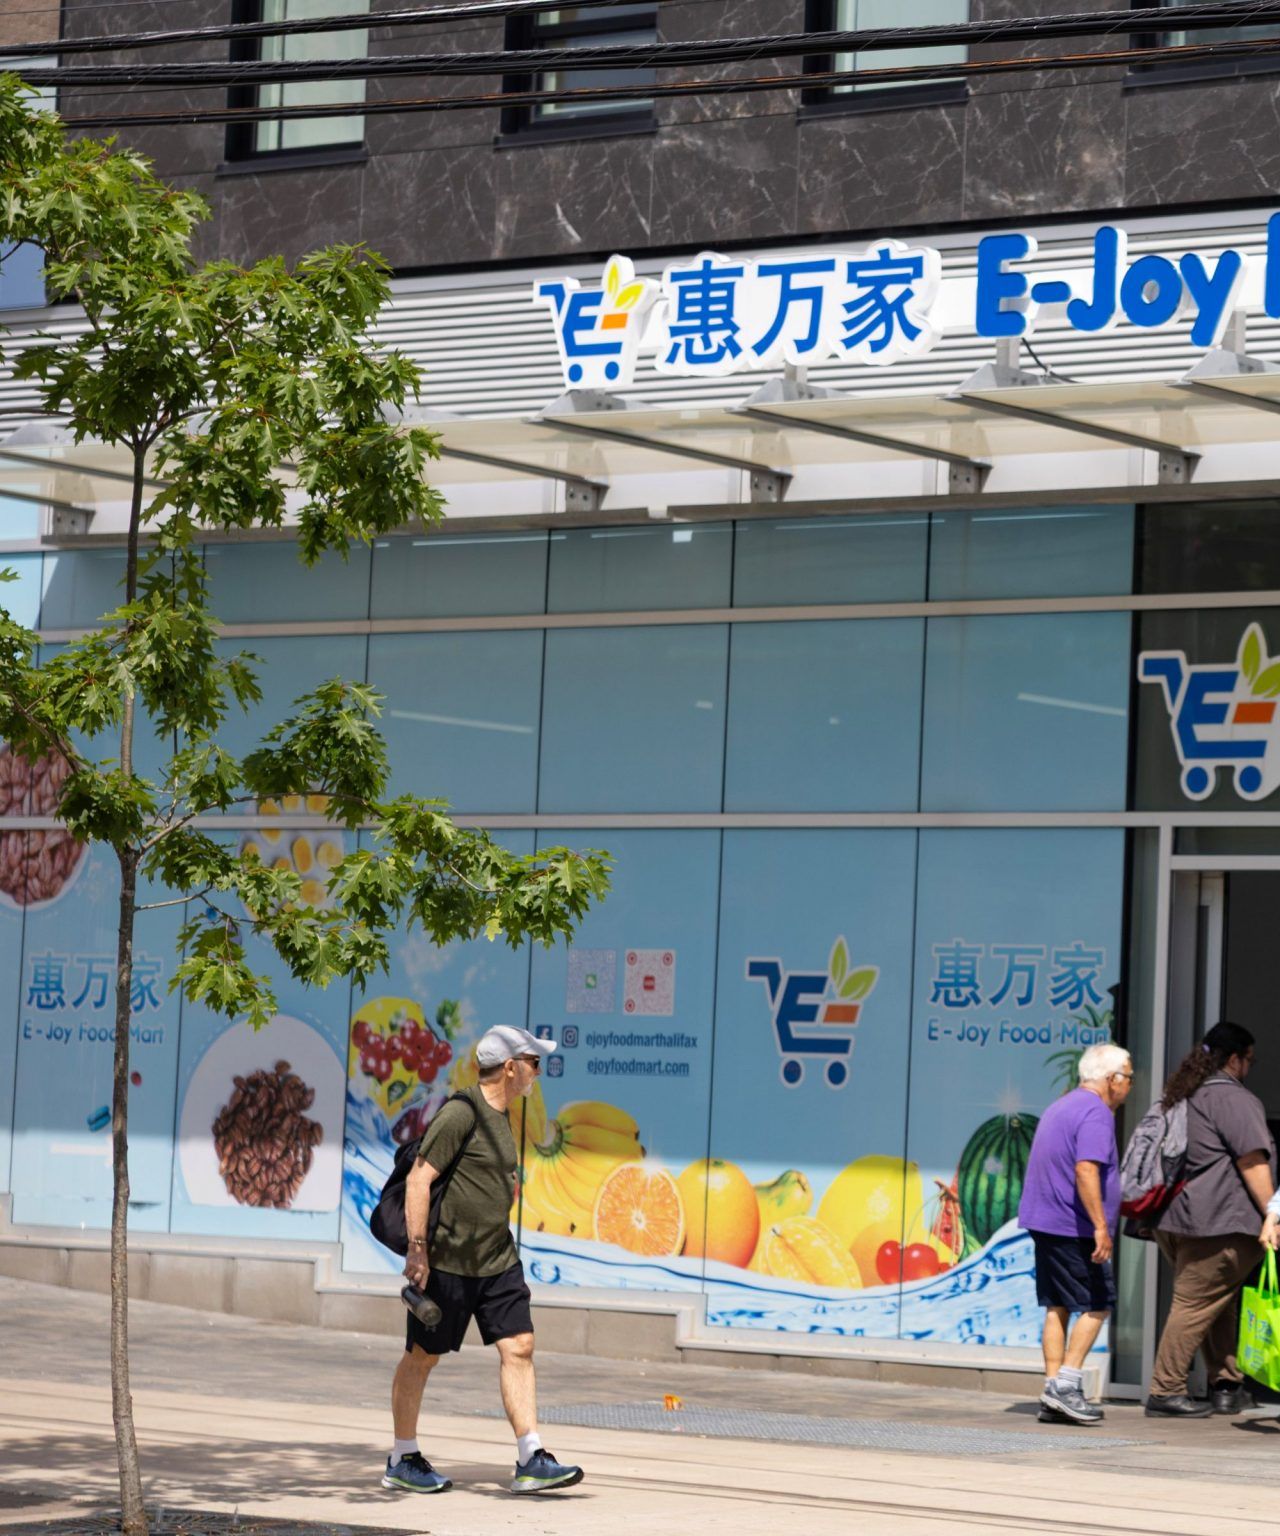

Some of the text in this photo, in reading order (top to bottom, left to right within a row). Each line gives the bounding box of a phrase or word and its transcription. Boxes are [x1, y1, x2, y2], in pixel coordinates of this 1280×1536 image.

[665, 248, 923, 365] 惠万家
[976, 226, 1242, 347] E-Joy
[929, 940, 1105, 1010] 惠万家
[585, 1031, 698, 1048] ejoyfoodmarthalifax
[999, 1020, 1052, 1043] Food
[1060, 1021, 1109, 1045] Mart
[586, 1058, 690, 1077] ejoyfoodmart.com
